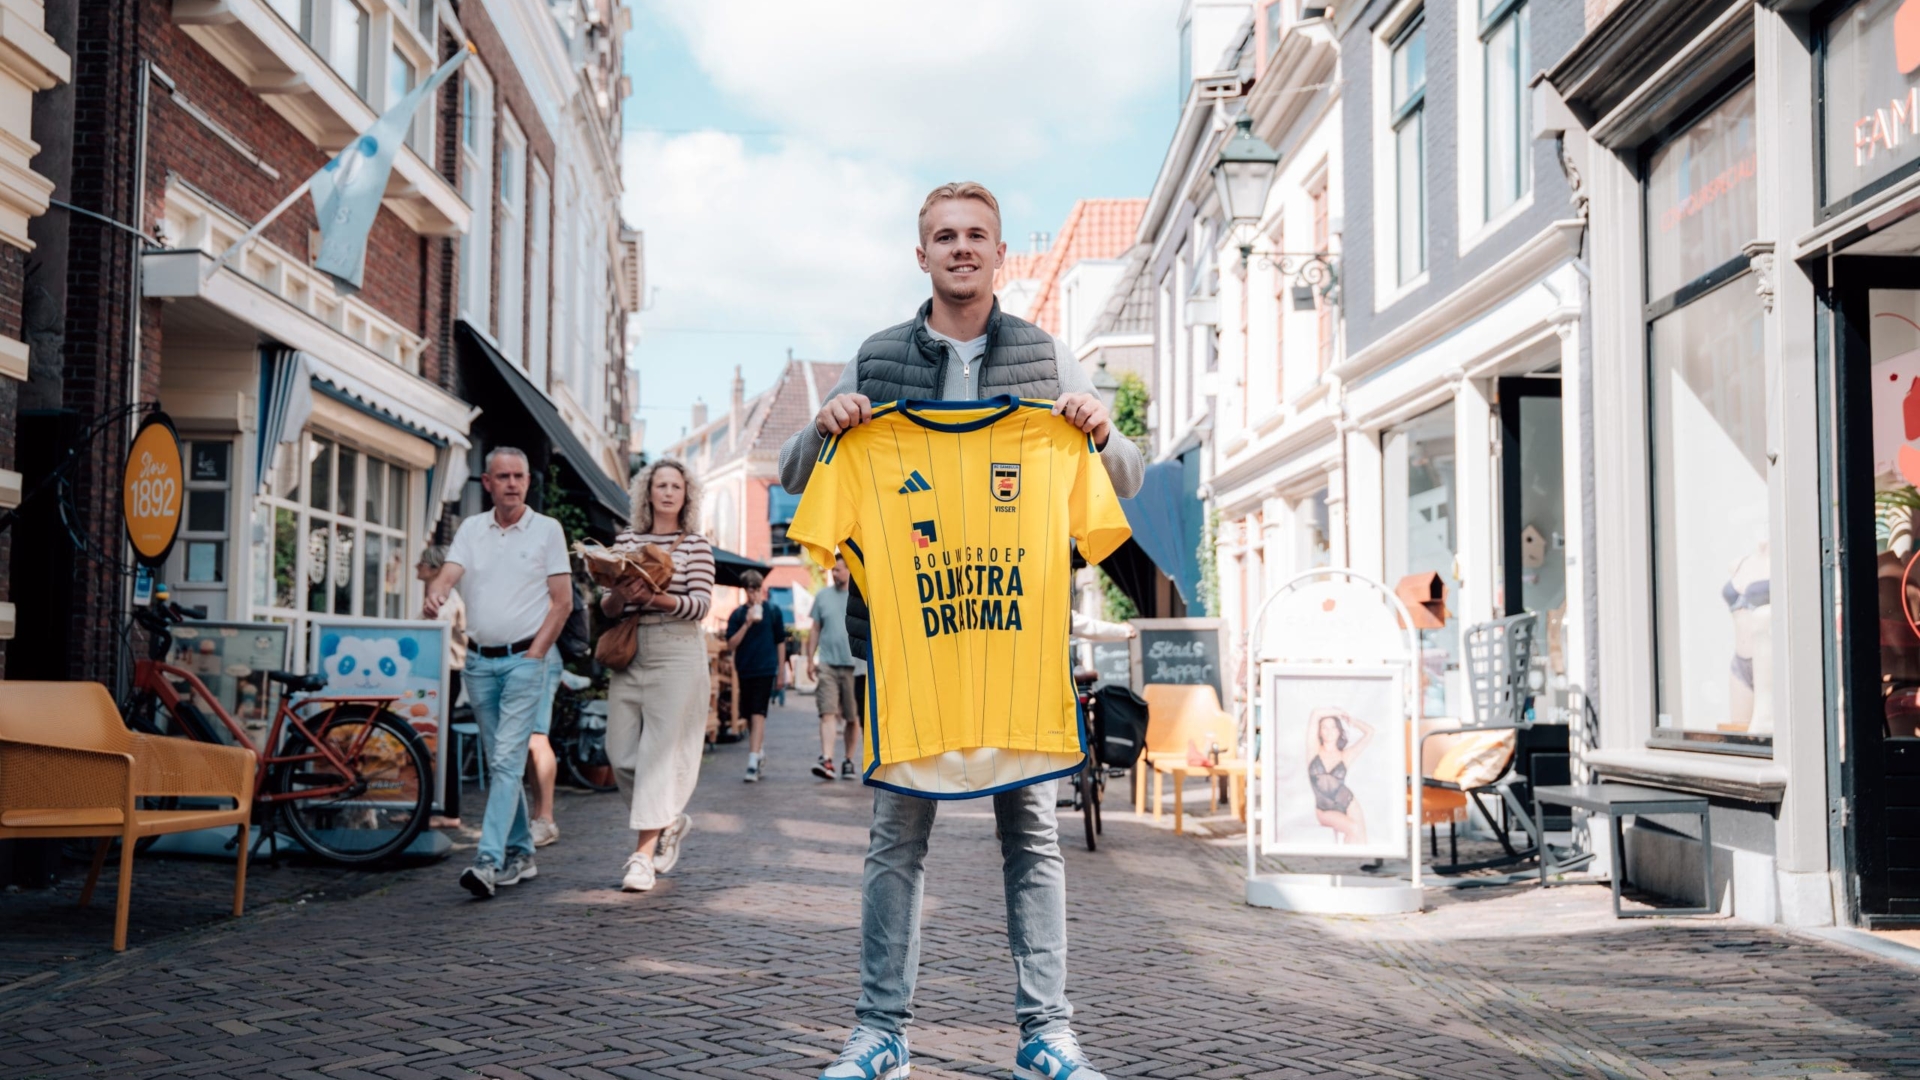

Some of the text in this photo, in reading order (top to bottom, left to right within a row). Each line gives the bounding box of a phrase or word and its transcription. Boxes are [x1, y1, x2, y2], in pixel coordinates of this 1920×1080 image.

[1854, 87, 1918, 167] FAM
[140, 452, 168, 478] Store
[131, 478, 175, 518] 1892
[994, 505, 1016, 513] VISSER
[914, 547, 1025, 570] BOUWGROEP
[916, 564, 1024, 604] DIJKSTRA
[921, 598, 1023, 638] DRAISMA
